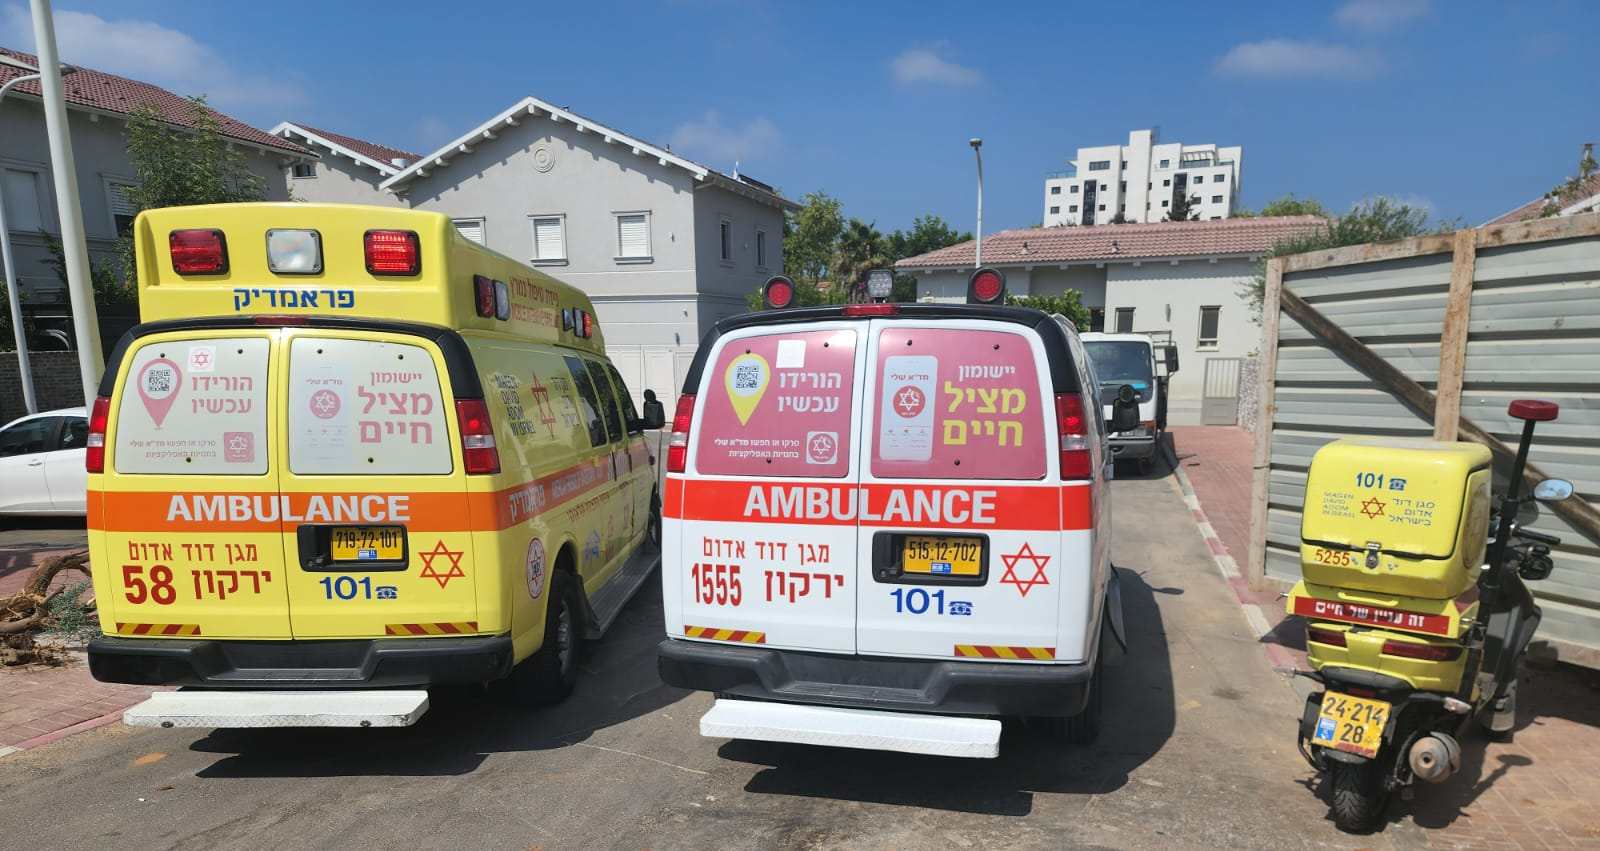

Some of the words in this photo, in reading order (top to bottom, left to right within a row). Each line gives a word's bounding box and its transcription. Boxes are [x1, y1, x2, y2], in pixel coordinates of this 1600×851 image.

[233, 287, 355, 311] פראמדיק
[191, 376, 253, 391] הורידו
[370, 371, 422, 386] יישומון
[779, 372, 842, 389] הורידו
[959, 365, 1016, 382] יישומון
[191, 399, 252, 414] עכשיו
[358, 385, 433, 416] מציל
[777, 396, 840, 412] עכשיו
[944, 380, 1026, 414] מציל
[358, 420, 433, 444] חיים
[943, 419, 1024, 447] חיים
[1356, 472, 1384, 489] 101
[166, 495, 411, 523] AMBULANCE
[743, 485, 997, 524] AMBULANCE
[128, 540, 173, 561] אדום
[181, 543, 215, 561] דוד
[225, 543, 258, 565] מגן
[703, 536, 746, 559] אדום
[755, 541, 788, 561] דוד
[798, 543, 830, 566] מגן
[1315, 549, 1350, 567] 5255
[122, 565, 177, 605] 58
[191, 570, 272, 600] ירקון
[319, 576, 372, 600] 101
[691, 563, 742, 606] 1555
[764, 570, 844, 603] ירקון
[890, 588, 946, 615] 101
[1315, 601, 1344, 616] חיים
[1349, 605, 1369, 619] של
[1408, 614, 1425, 627] זה
[1340, 723, 1364, 744] 28
